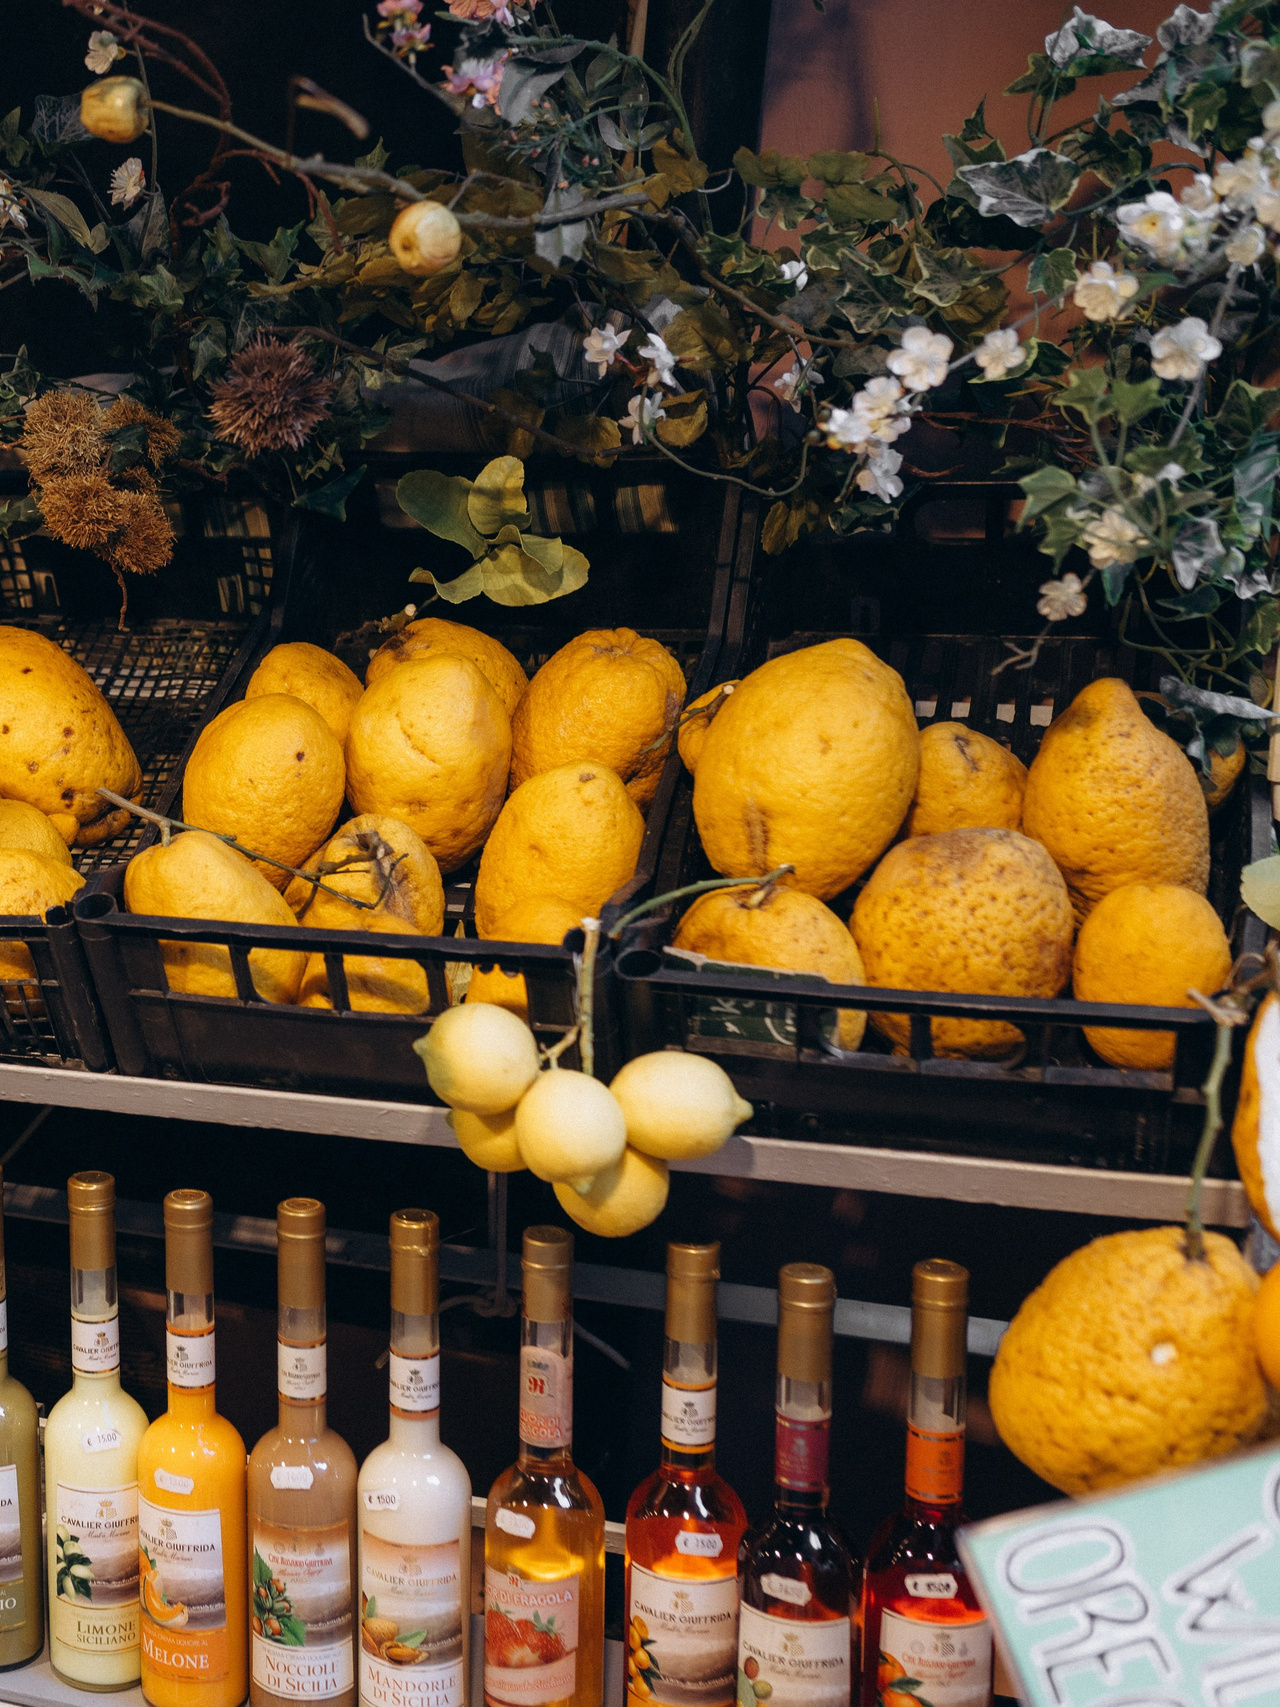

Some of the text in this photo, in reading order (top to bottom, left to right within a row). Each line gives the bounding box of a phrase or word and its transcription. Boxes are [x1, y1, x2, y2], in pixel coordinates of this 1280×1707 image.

[61, 1515, 102, 1530] CAVALIER
[166, 1543, 216, 1553] GIUFFRIDA
[366, 1566, 457, 1587] CAVALIER GIUFFRIDA
[514, 1589, 573, 1607] FRAGOLA
[634, 1600, 677, 1623] CAVALIER
[77, 1620, 136, 1636] LIMONE
[76, 1632, 136, 1645] SICILIANO
[142, 1632, 210, 1670] MELONE
[266, 1654, 339, 1677] NOCCIOLE
[268, 1673, 337, 1693] DI SICILIA
[368, 1665, 457, 1693] MANDORLE
[373, 1686, 387, 1702] DI
